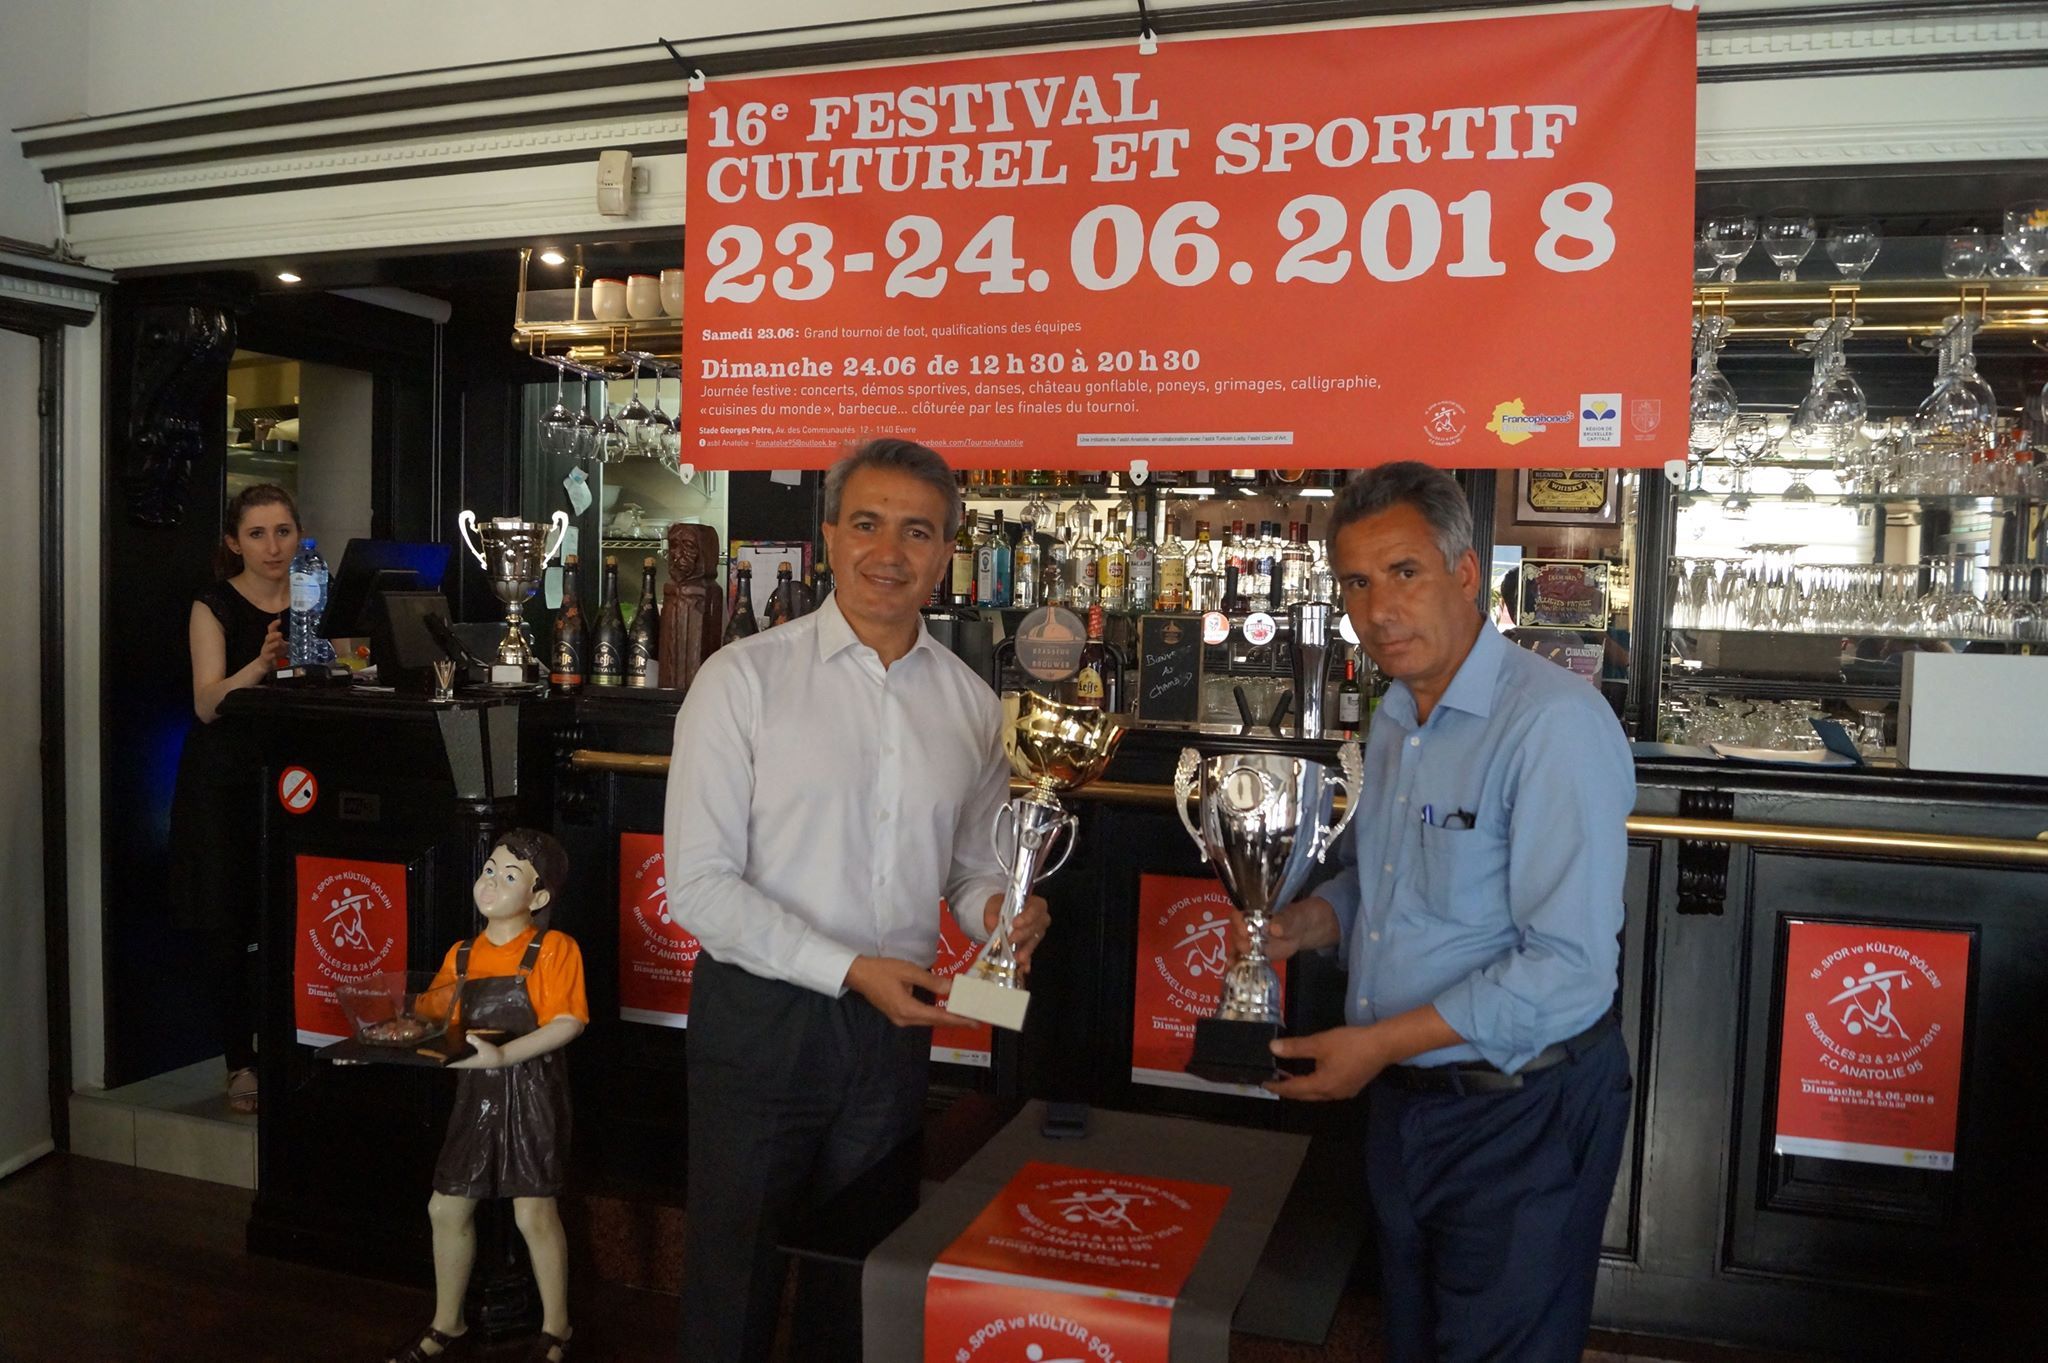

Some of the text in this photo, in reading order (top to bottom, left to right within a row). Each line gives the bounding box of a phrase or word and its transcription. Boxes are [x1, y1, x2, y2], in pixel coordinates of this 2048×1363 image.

[708, 73, 1159, 148] 16e FESTIVAL
[706, 105, 1577, 203] CULTUREL ET SPORTIF
[702, 328, 752, 341] Samedi
[804, 328, 837, 338] Grand
[842, 326, 882, 338] tournoi
[886, 325, 899, 337] de
[903, 325, 928, 338] foot,
[932, 323, 1007, 337] qualifications
[1011, 322, 1031, 333] des
[1035, 321, 1082, 335] équipes
[702, 357, 833, 379] Dimanche
[843, 356, 916, 377] 24.06
[927, 355, 959, 376] de
[1071, 349, 1088, 372] à
[701, 384, 748, 397] Journée
[801, 384, 857, 397] concerts,
[862, 383, 903, 396] démos
[908, 383, 970, 396] sportives,
[974, 382, 1024, 396] danses,
[1029, 380, 1081, 393] château
[1085, 380, 1152, 395] gonflable,
[1157, 381, 1209, 394] poneys,
[1214, 378, 1286, 393] grimages,
[1291, 375, 1381, 391] calligraphie,
[761, 403, 776, 415] du
[839, 401, 907, 415] barbecue...
[912, 400, 964, 414] clôturée
[969, 402, 991, 415] par
[995, 401, 1014, 413] les
[1018, 400, 1062, 413] finales
[1066, 401, 1082, 412] du
[1087, 400, 1139, 413] tournoi.
[699, 426, 718, 434] Stade
[720, 426, 750, 435] Georges
[752, 426, 774, 435] Petre,
[788, 426, 800, 434] des
[802, 425, 855, 434] Communautés
[1502, 415, 1570, 425] Francophones
[1551, 482, 1584, 490] WHISKY
[633, 906, 697, 949] BRUXELLES 23 & 24
[309, 929, 341, 970] BRUXELLES
[360, 961, 369, 971] 24
[1851, 946, 1864, 954] ve
[1866, 942, 1909, 960] KÜLTÜR
[938, 967, 949, 976] 24
[949, 961, 964, 976] juin
[1154, 956, 1198, 1000] BRUXELLES
[1199, 995, 1211, 1003] 23
[1805, 1012, 1942, 1064] BRUXELLES 23 & 24 juin 2018
[1839, 1064, 1906, 1080] ANATOLIE
[1907, 1061, 1923, 1075] 95
[1802, 1083, 1863, 1098] Dimanche
[1008, 1317, 1025, 1330] ve
[1028, 1312, 1089, 1343] KÜLTÜR
